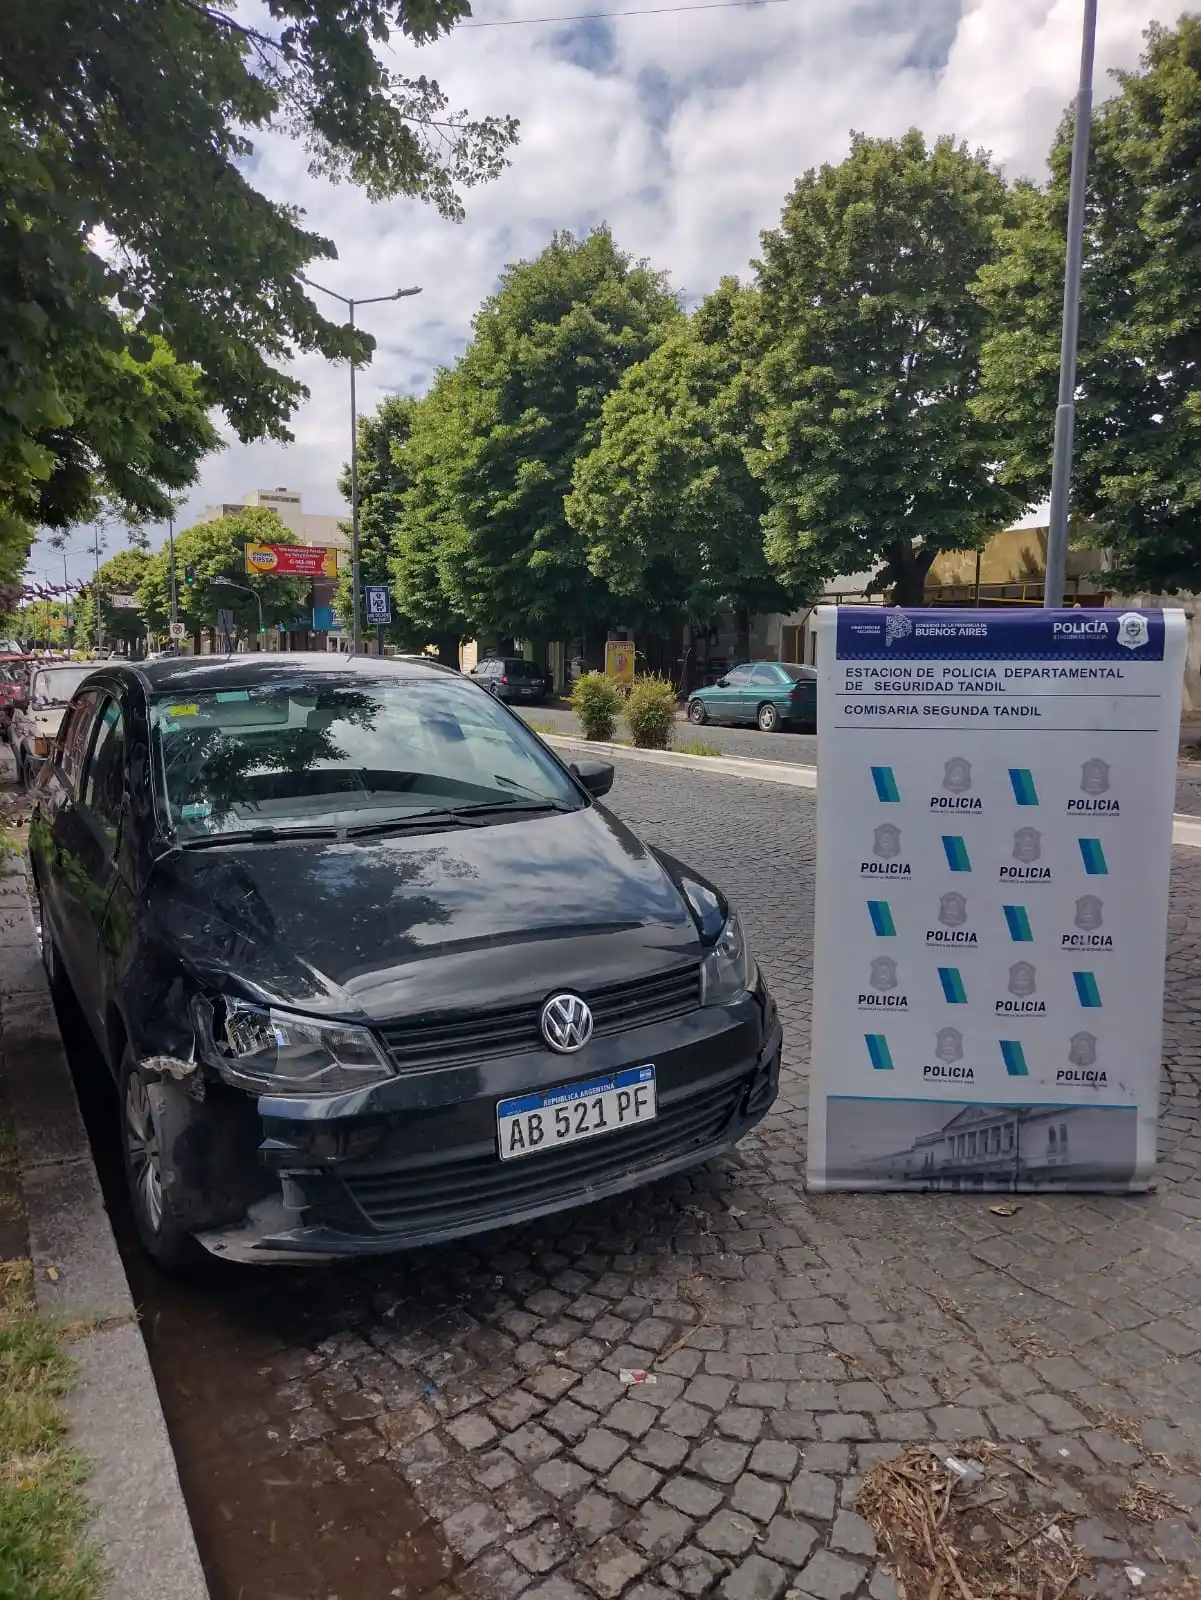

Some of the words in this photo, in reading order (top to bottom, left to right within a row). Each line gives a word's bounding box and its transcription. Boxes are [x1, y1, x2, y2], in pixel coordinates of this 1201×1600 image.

[915, 628, 956, 636] BUENOS
[959, 628, 988, 636] AIRES
[1053, 620, 1109, 633] POLICÍA
[846, 667, 912, 678] ESTACION
[917, 668, 934, 678] DE
[942, 668, 996, 679] POLICIA
[1004, 668, 1124, 679] DEPARTAMENTAL
[845, 681, 863, 691] DE
[874, 681, 953, 692] SEGURIDAD
[958, 682, 1006, 692] TANDIL
[844, 704, 919, 715] COMISARIA
[922, 705, 989, 716] SEGUNDA
[994, 706, 1042, 717] TANDIL
[930, 797, 983, 809] POLICIA
[1067, 799, 1120, 811] POLICIA
[860, 862, 912, 874] POLICIA
[999, 866, 1052, 878] POLICIA
[925, 930, 978, 943] POLICIA
[1061, 934, 1113, 946] POLICIA
[858, 994, 908, 1006] POLICIA
[995, 1000, 1046, 1012] POLICIA
[923, 1066, 974, 1078] POLICIA
[1056, 1070, 1108, 1082] POLICIA
[543, 1092, 579, 1107] REPUBLICA
[580, 1082, 615, 1098] ARGENTINA
[509, 1113, 545, 1151] AB
[554, 1097, 607, 1138] 521
[616, 1085, 648, 1122] PF
